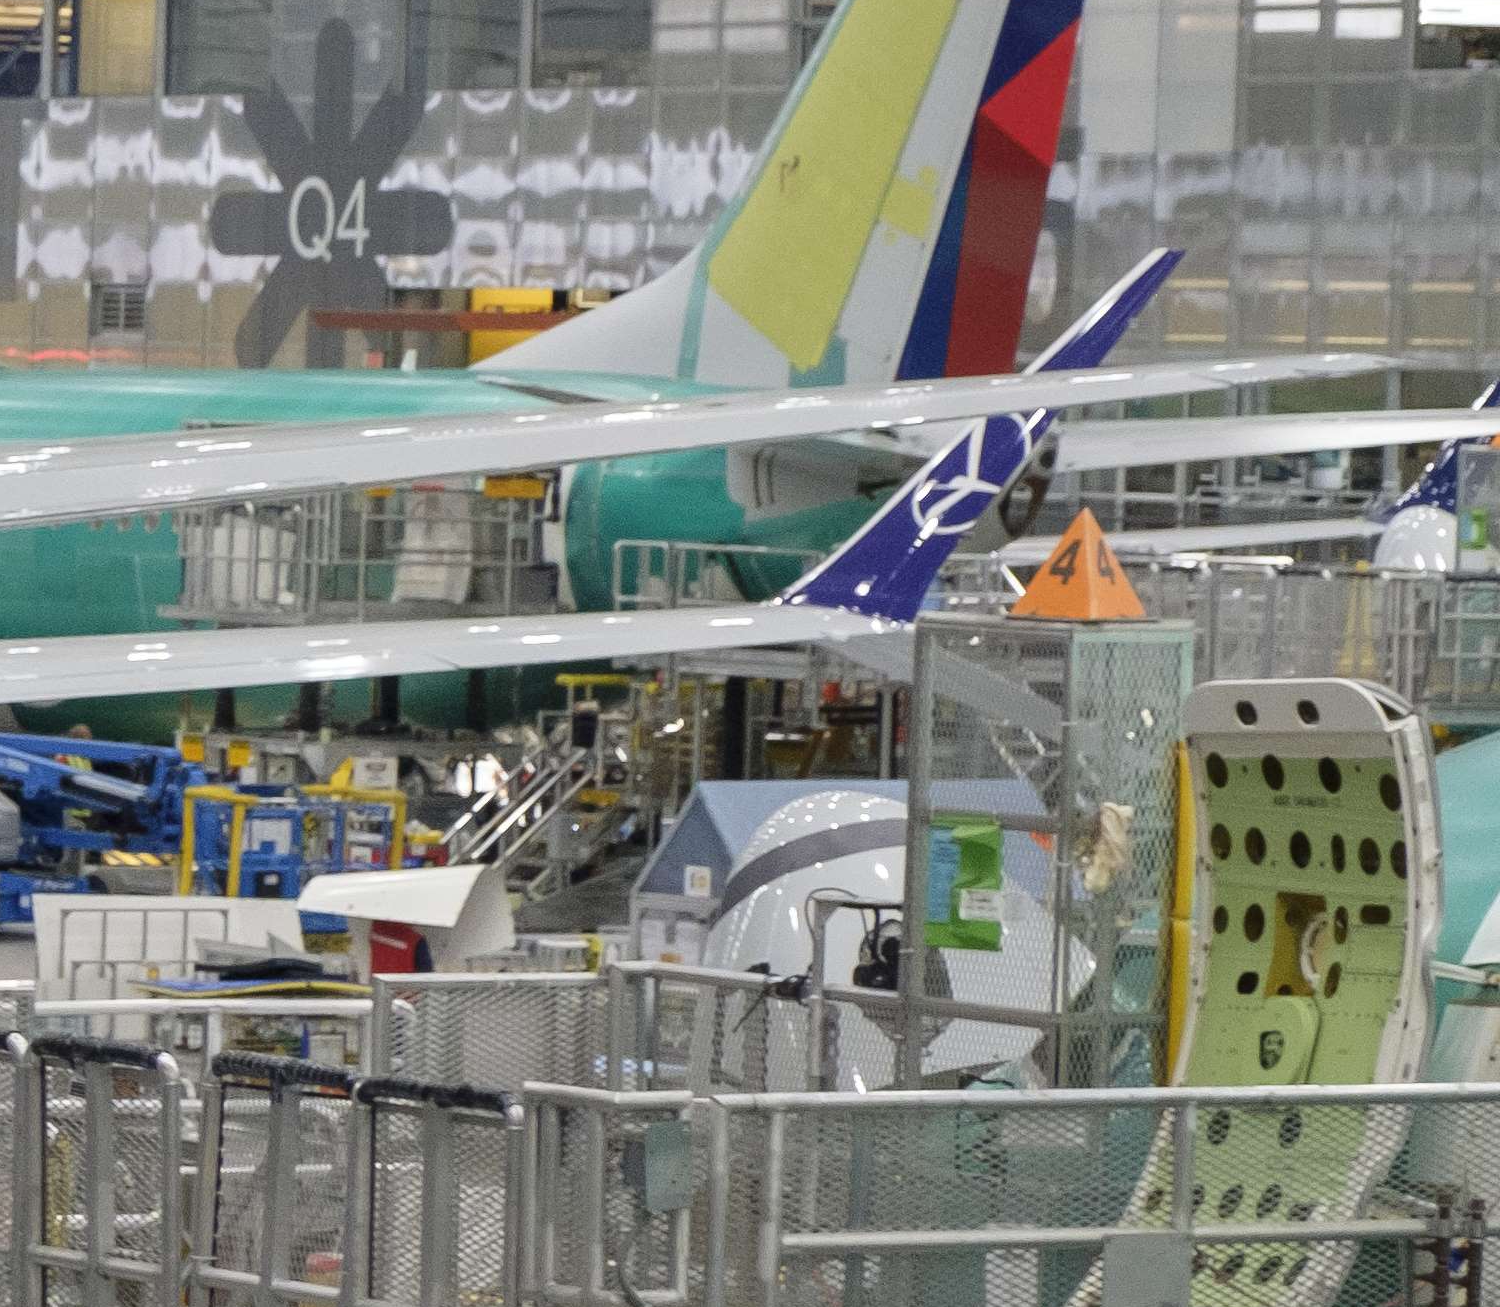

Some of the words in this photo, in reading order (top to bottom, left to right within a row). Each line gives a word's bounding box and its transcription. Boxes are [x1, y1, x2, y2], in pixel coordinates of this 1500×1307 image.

[288, 175, 371, 263] Q4
[1049, 539, 1083, 585] 4
[1097, 539, 1116, 585] 4
